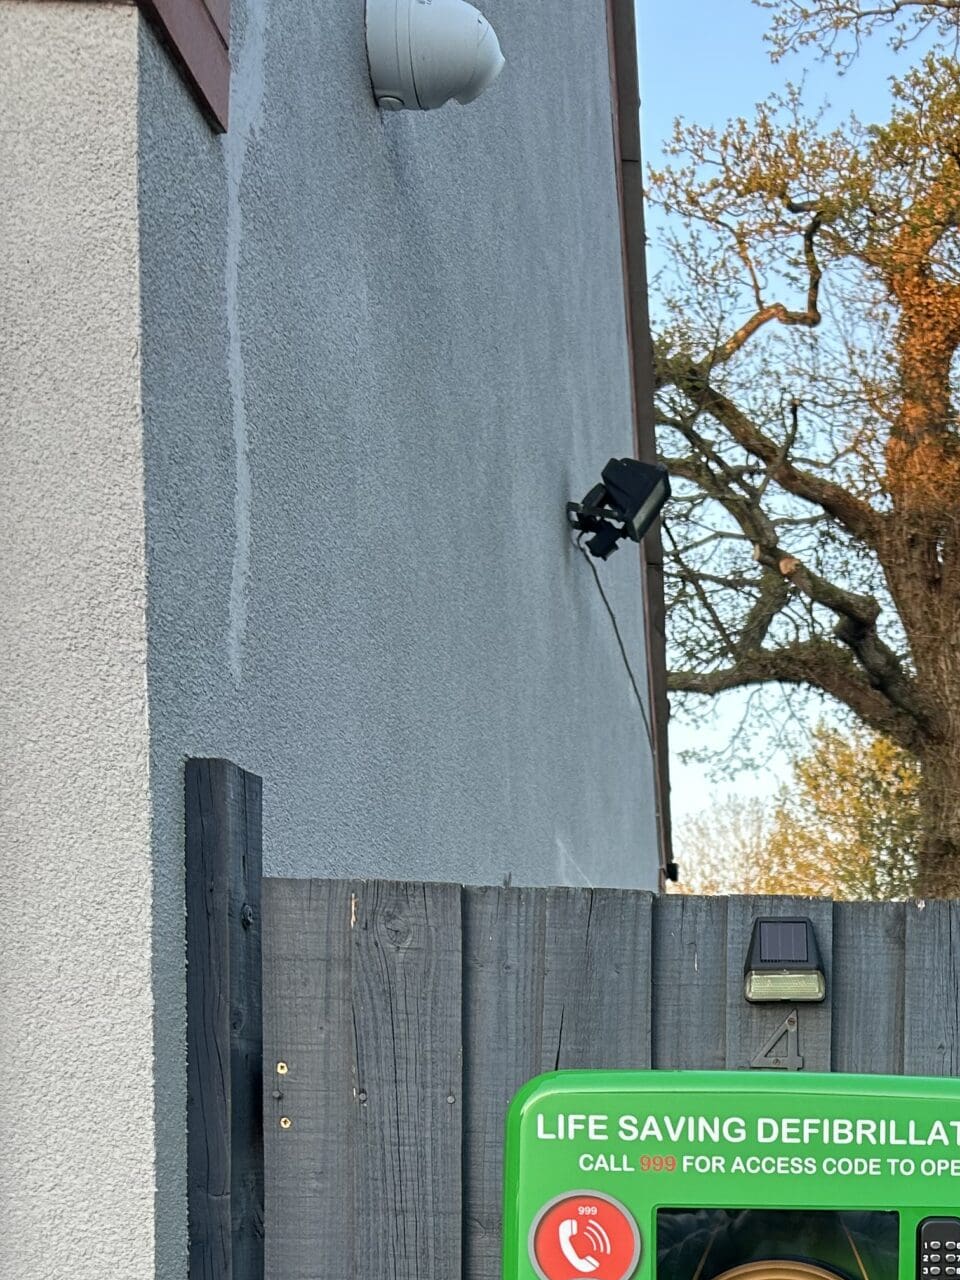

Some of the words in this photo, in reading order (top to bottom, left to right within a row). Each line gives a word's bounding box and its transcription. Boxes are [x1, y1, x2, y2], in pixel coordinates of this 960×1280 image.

[751, 1008, 804, 1071] 4
[537, 1114, 609, 1140] LIFE
[618, 1114, 746, 1143] SAVING
[579, 1154, 635, 1172] CALL
[640, 1155, 677, 1172] 999
[682, 1156, 726, 1173] FOR
[730, 1156, 817, 1175] ACCESS
[822, 1158, 881, 1175] CODE
[887, 1159, 915, 1176] TO
[578, 1206, 598, 1216] 999
